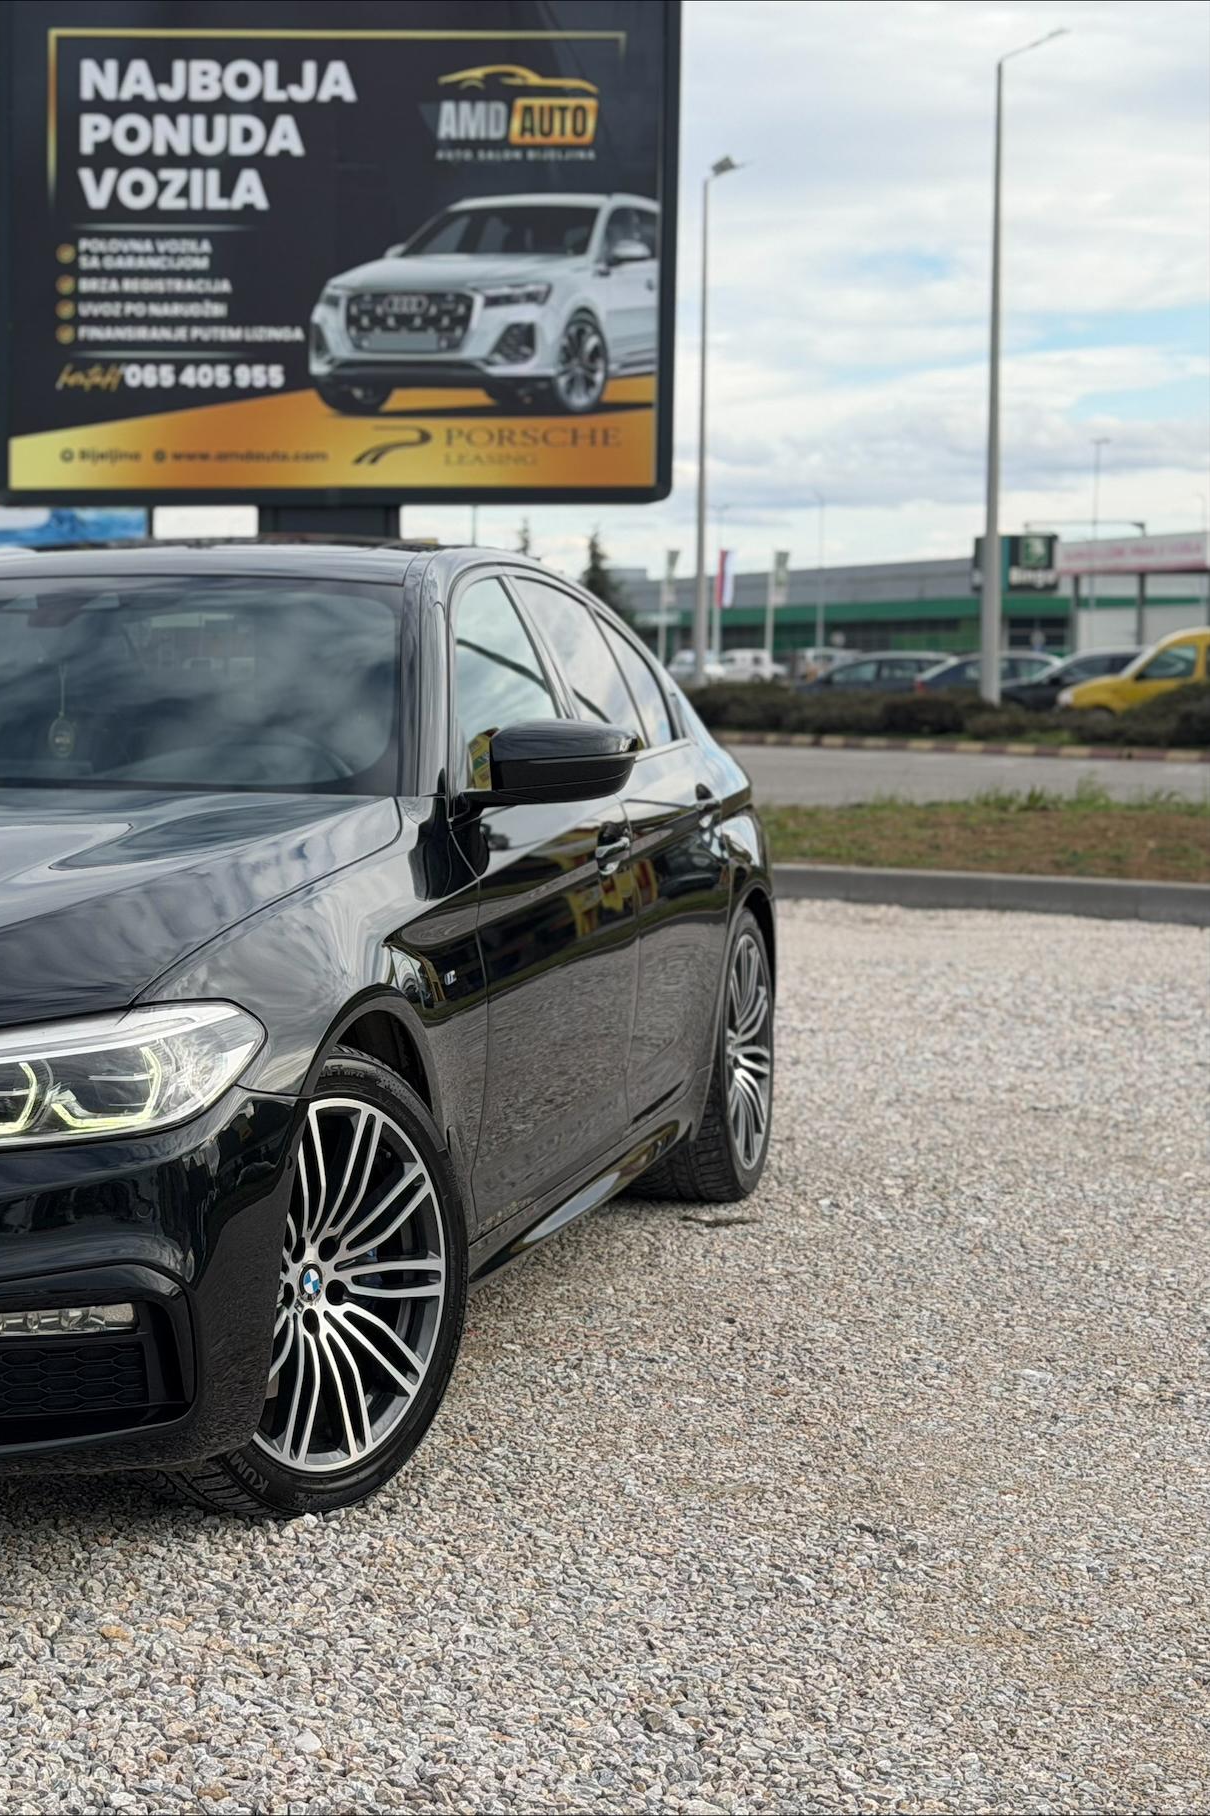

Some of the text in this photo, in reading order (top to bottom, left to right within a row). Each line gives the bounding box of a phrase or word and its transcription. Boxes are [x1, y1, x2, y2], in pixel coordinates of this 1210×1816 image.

[79, 58, 356, 102] NAJBOLJA
[437, 101, 587, 140] AMD AUTO
[79, 114, 305, 156] PONUDA
[79, 168, 270, 211] VOZILA
[78, 238, 213, 254] POLOVNA VOZILA
[78, 255, 210, 270] SA GARANCIJOM
[78, 278, 232, 294] BRZA REGISTRACIJA
[78, 302, 123, 317] UVOZ
[124, 302, 147, 317] PO
[78, 326, 188, 341] FINANSIRANJE
[190, 326, 242, 341] PUTEM
[124, 363, 176, 388] 065
[178, 363, 232, 388] 405
[234, 363, 285, 388] 955
[445, 427, 621, 448] PORSCHE
[445, 454, 537, 466] LEASING
